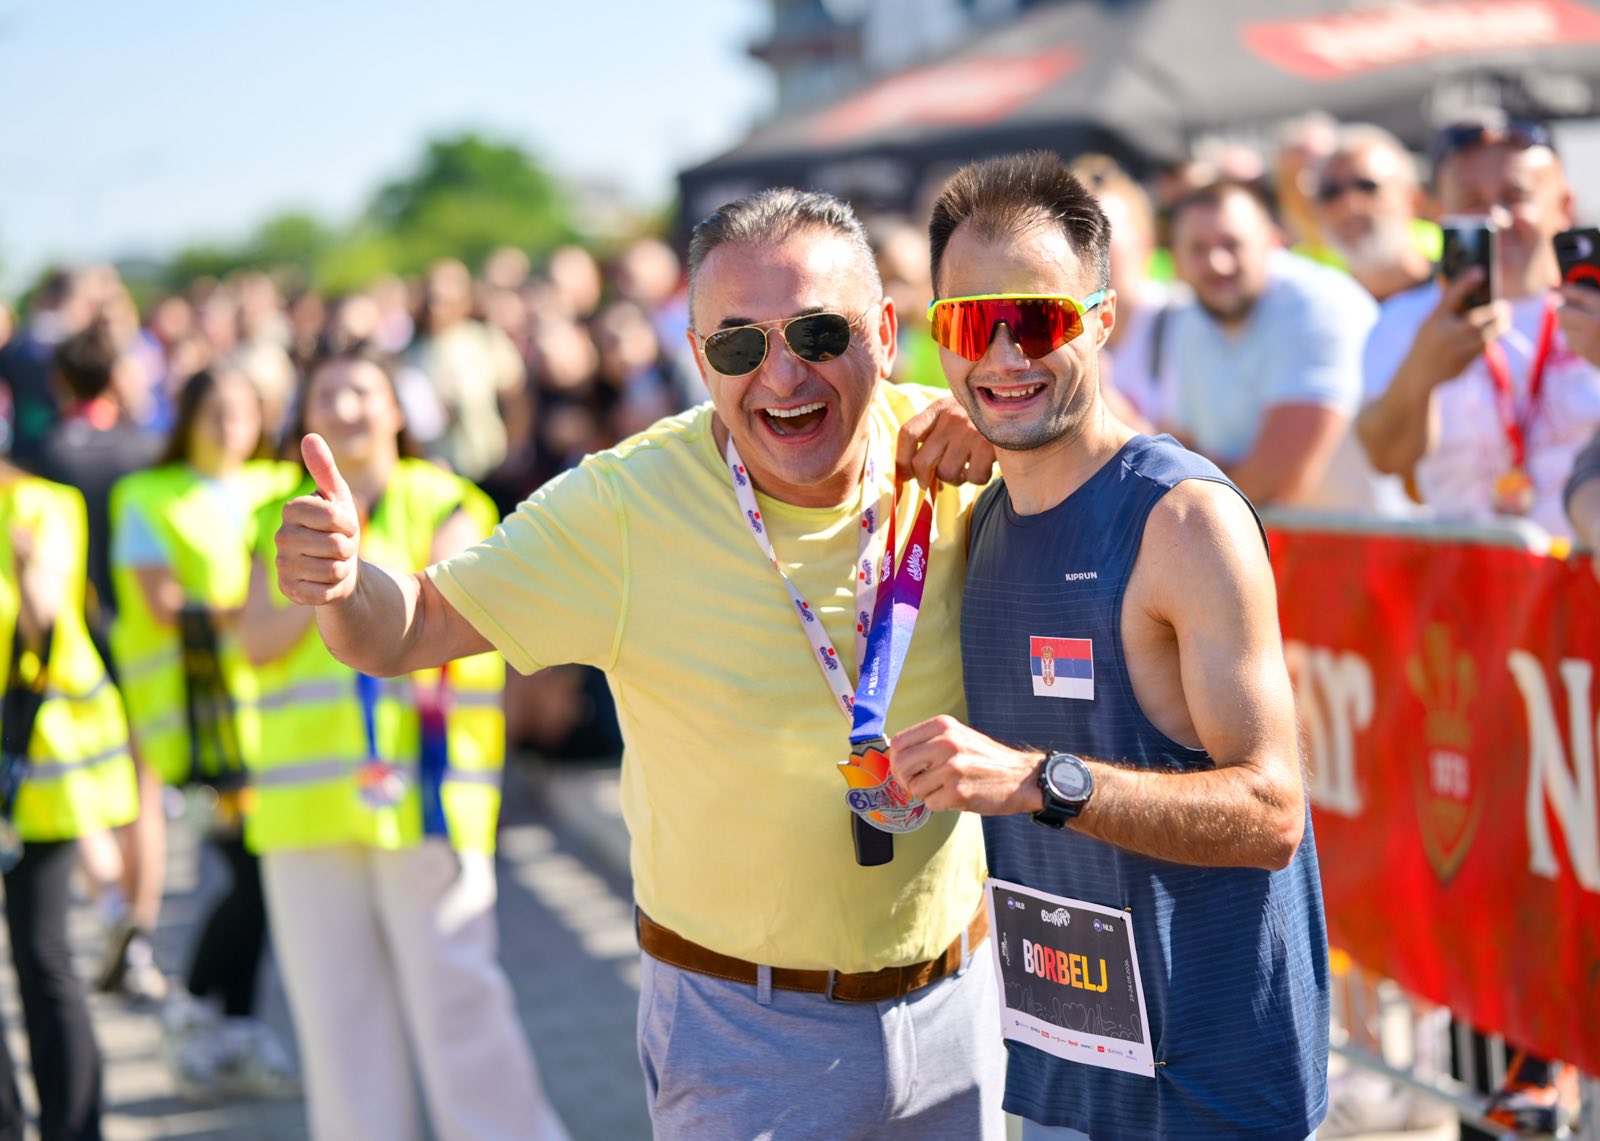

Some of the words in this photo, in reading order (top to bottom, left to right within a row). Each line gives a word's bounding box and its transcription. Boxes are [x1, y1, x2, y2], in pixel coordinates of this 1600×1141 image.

[1015, 901, 1025, 910] NLB
[1102, 923, 1114, 933] NLB
[1022, 938, 1108, 993] BORBELJ
